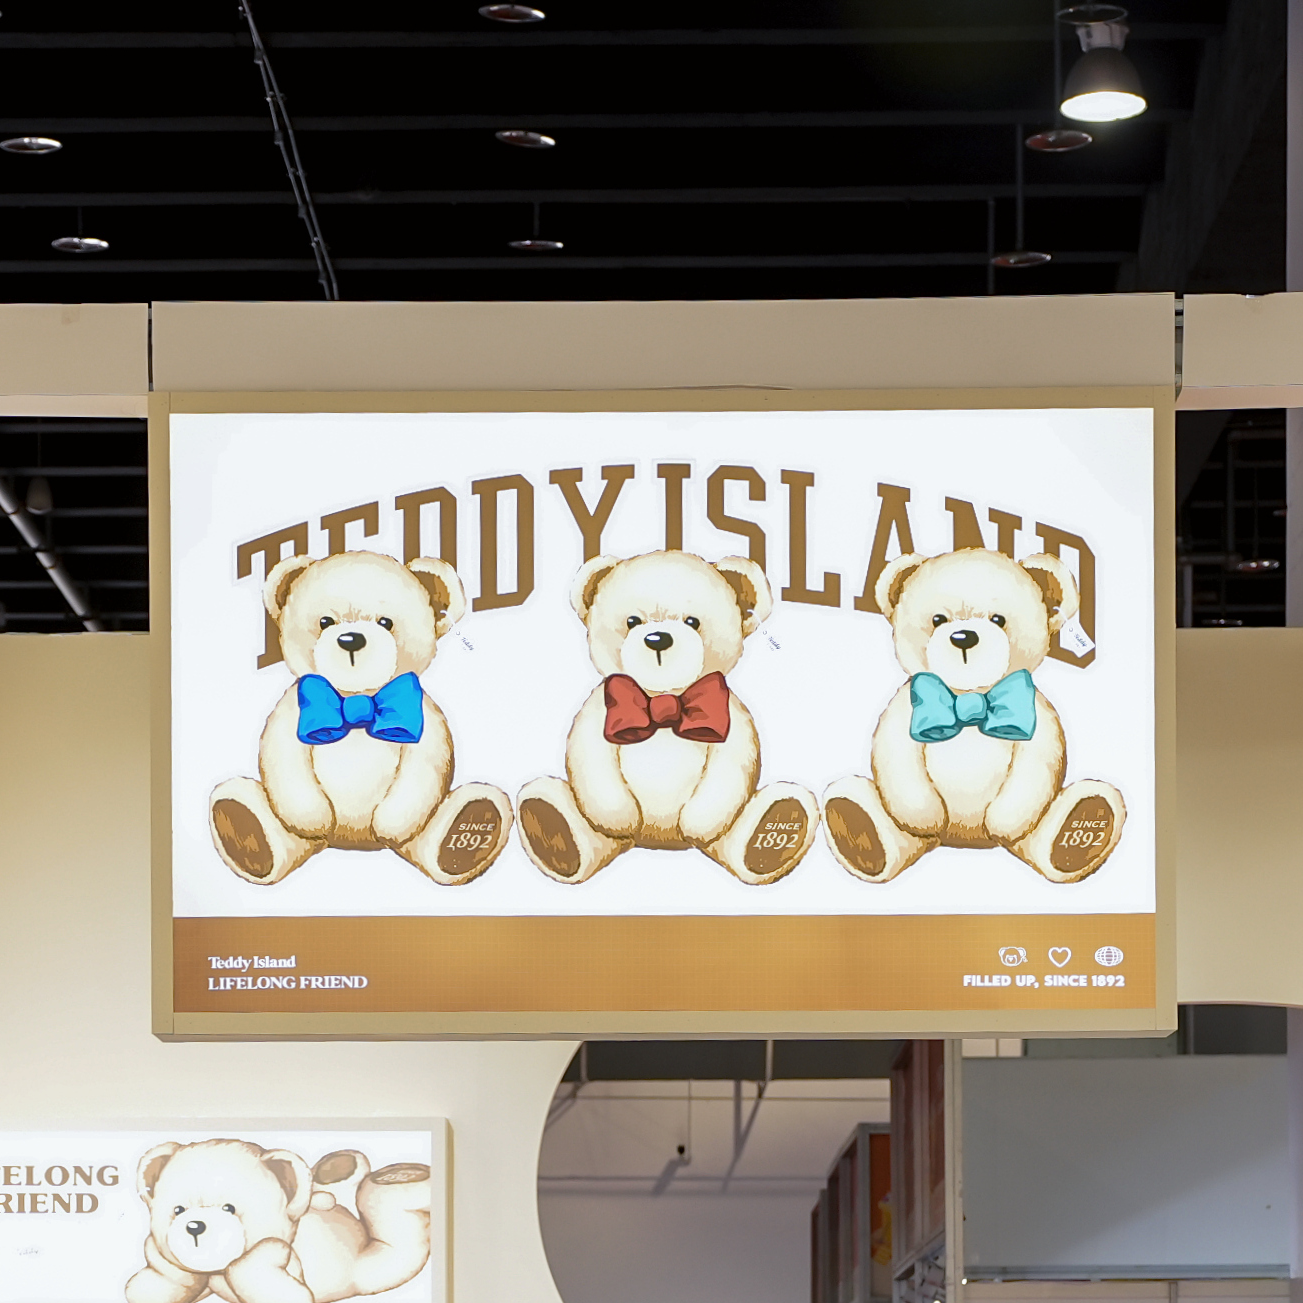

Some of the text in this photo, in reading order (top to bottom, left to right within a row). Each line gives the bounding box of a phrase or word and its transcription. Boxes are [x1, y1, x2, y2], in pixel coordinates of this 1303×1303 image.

[458, 823, 495, 831] SINCE
[764, 822, 802, 830] SINCE
[1071, 820, 1108, 828] SINCE
[446, 832, 492, 851] 1892
[752, 831, 799, 850] 1892
[1059, 829, 1105, 848] 1892
[208, 955, 296, 972] Teddy Island
[208, 975, 368, 990] LIFELONG FRIEND
[963, 974, 1125, 989] FILLED UP, SINCE 1892
